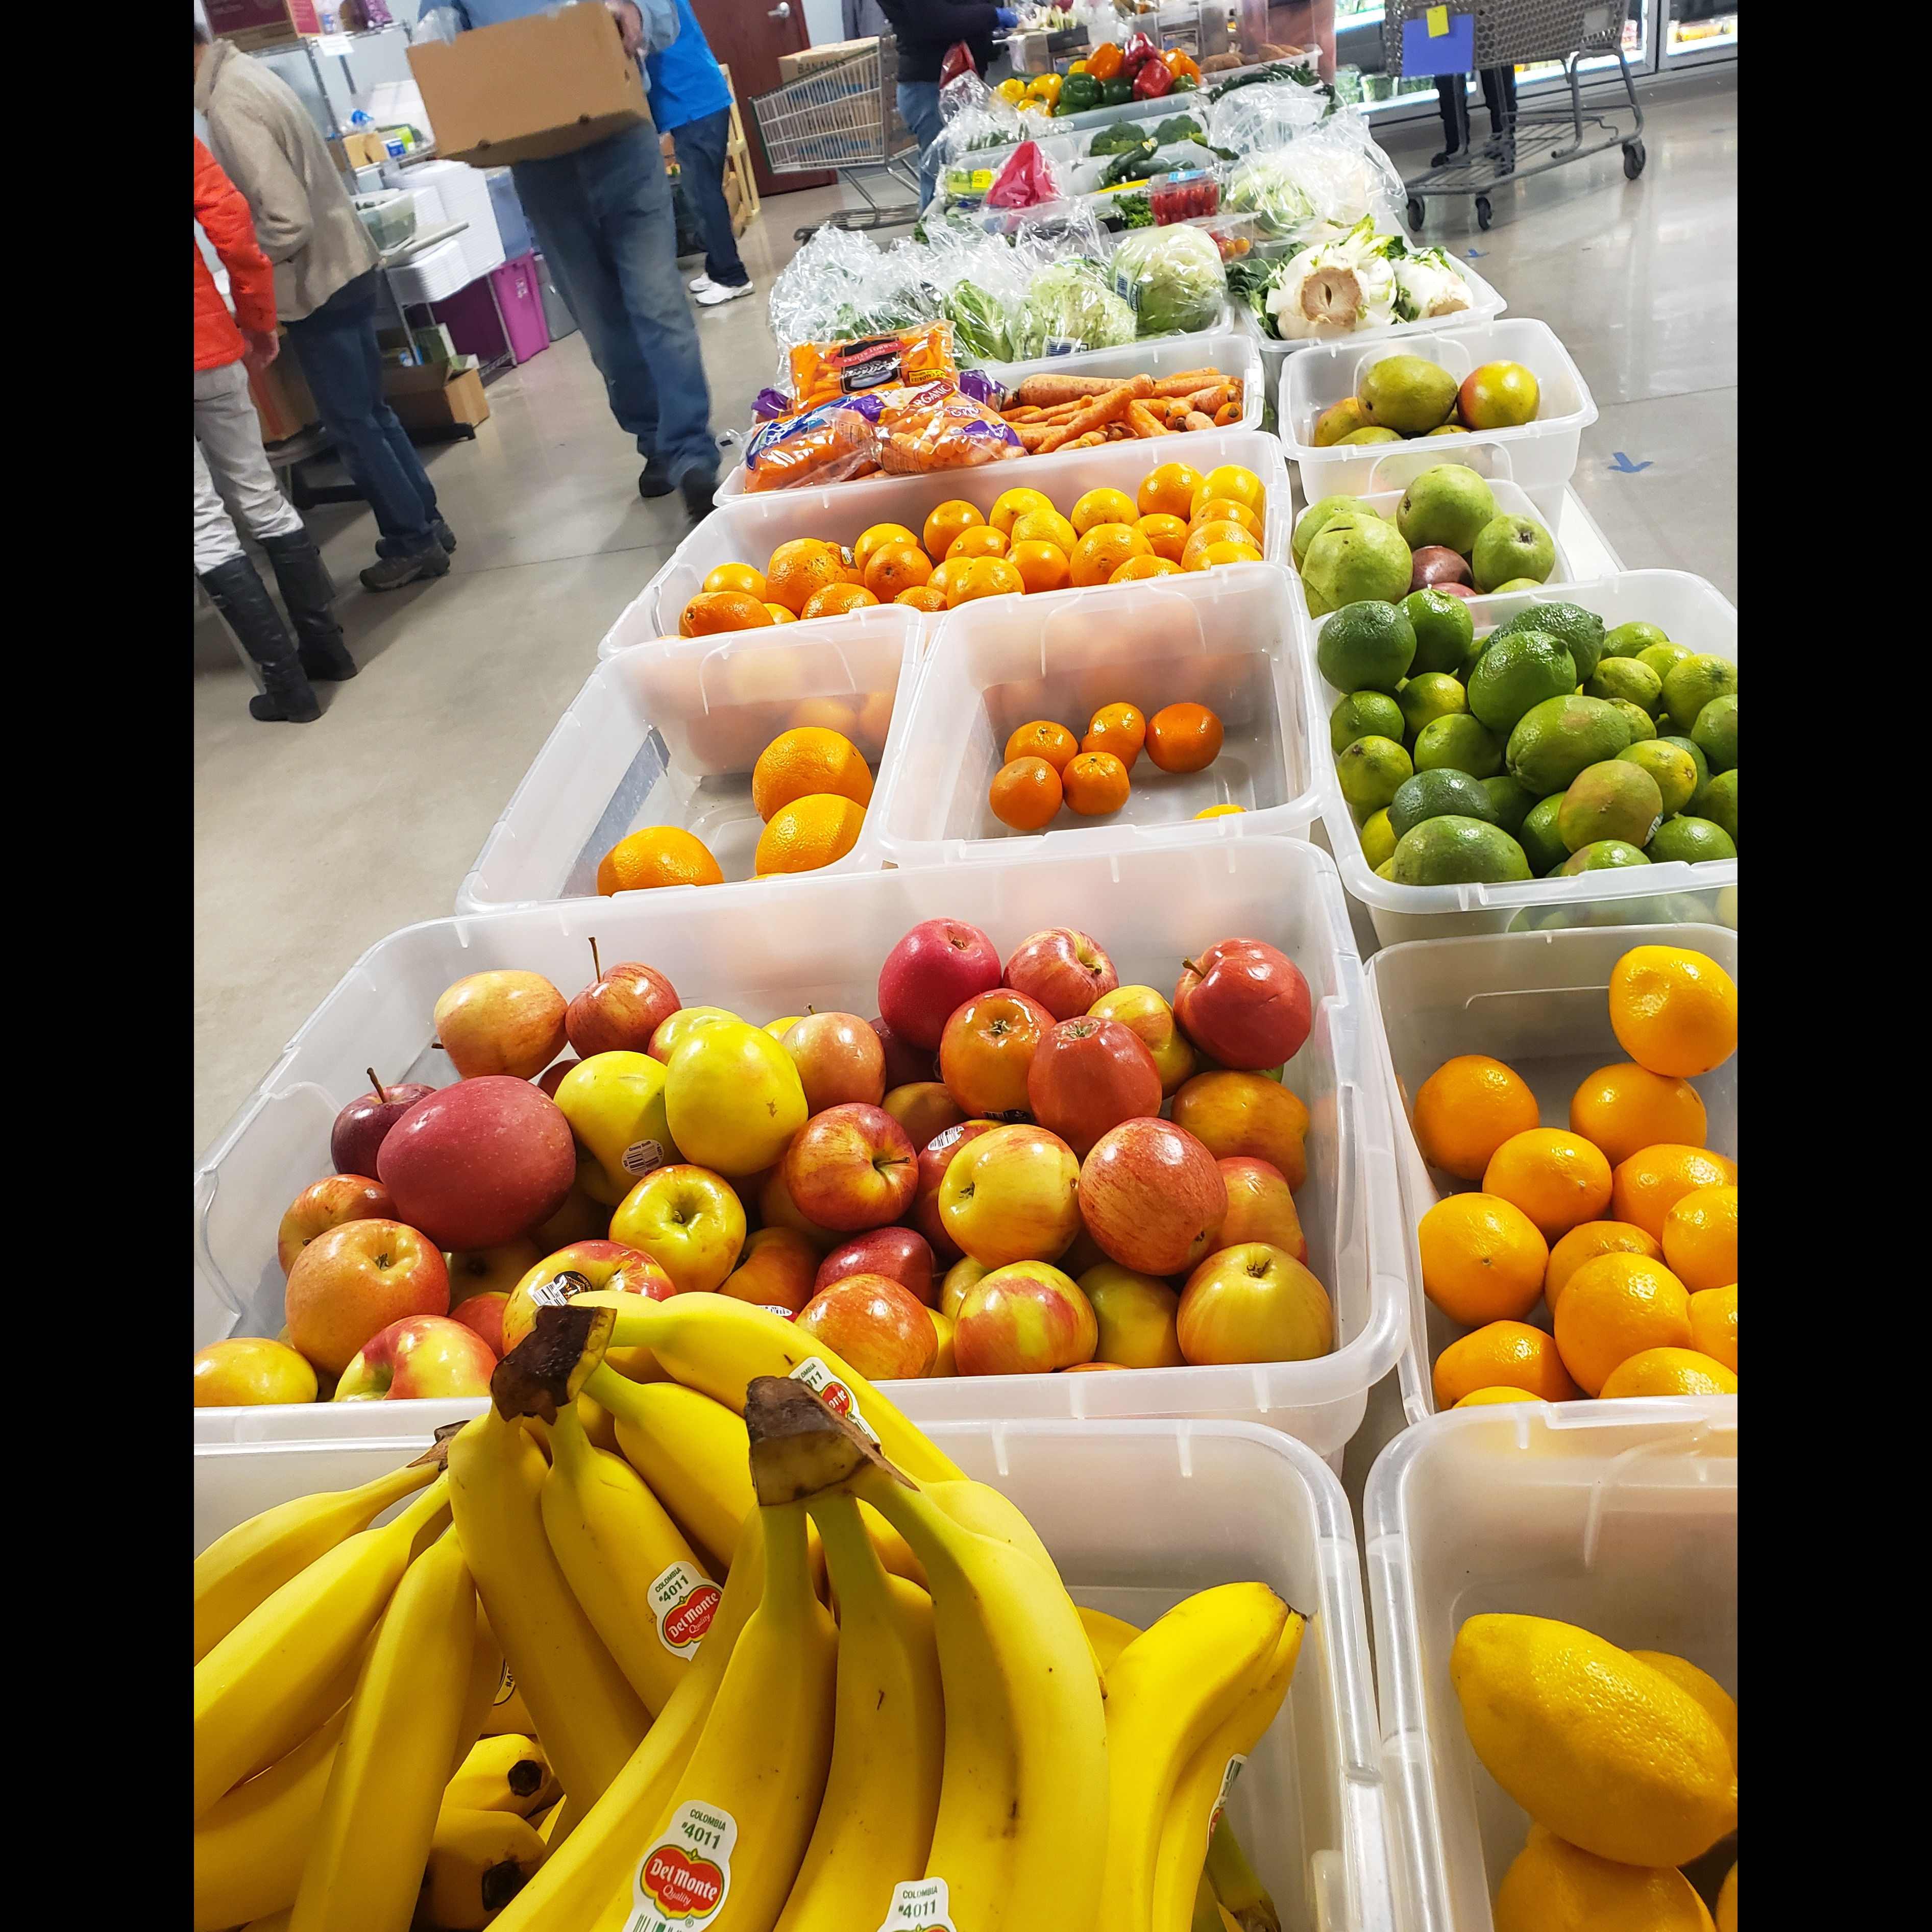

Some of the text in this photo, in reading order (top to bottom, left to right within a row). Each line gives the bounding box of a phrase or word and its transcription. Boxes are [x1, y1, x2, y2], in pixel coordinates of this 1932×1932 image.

[843, 343, 898, 363] CARROT STICKS
[911, 373, 935, 382] CALORIES
[913, 384, 952, 406] RGANIC
[797, 1362, 817, 1379] OMBIA
[806, 1371, 823, 1387] 011
[828, 1389, 847, 1409] onte
[655, 1567, 682, 1593] COLOMBIA
[659, 1575, 689, 1602] #4011
[668, 1593, 719, 1638] Del Monte
[689, 1613, 710, 1634] Quality
[690, 1808, 726, 1831] COLOMBIA
[681, 1821, 721, 1850] #4011
[650, 1858, 718, 1902] Del Monte
[663, 1884, 692, 1907] Quality
[902, 1885, 938, 1899] COLOMBIA
[898, 1898, 936, 1919] #4011
